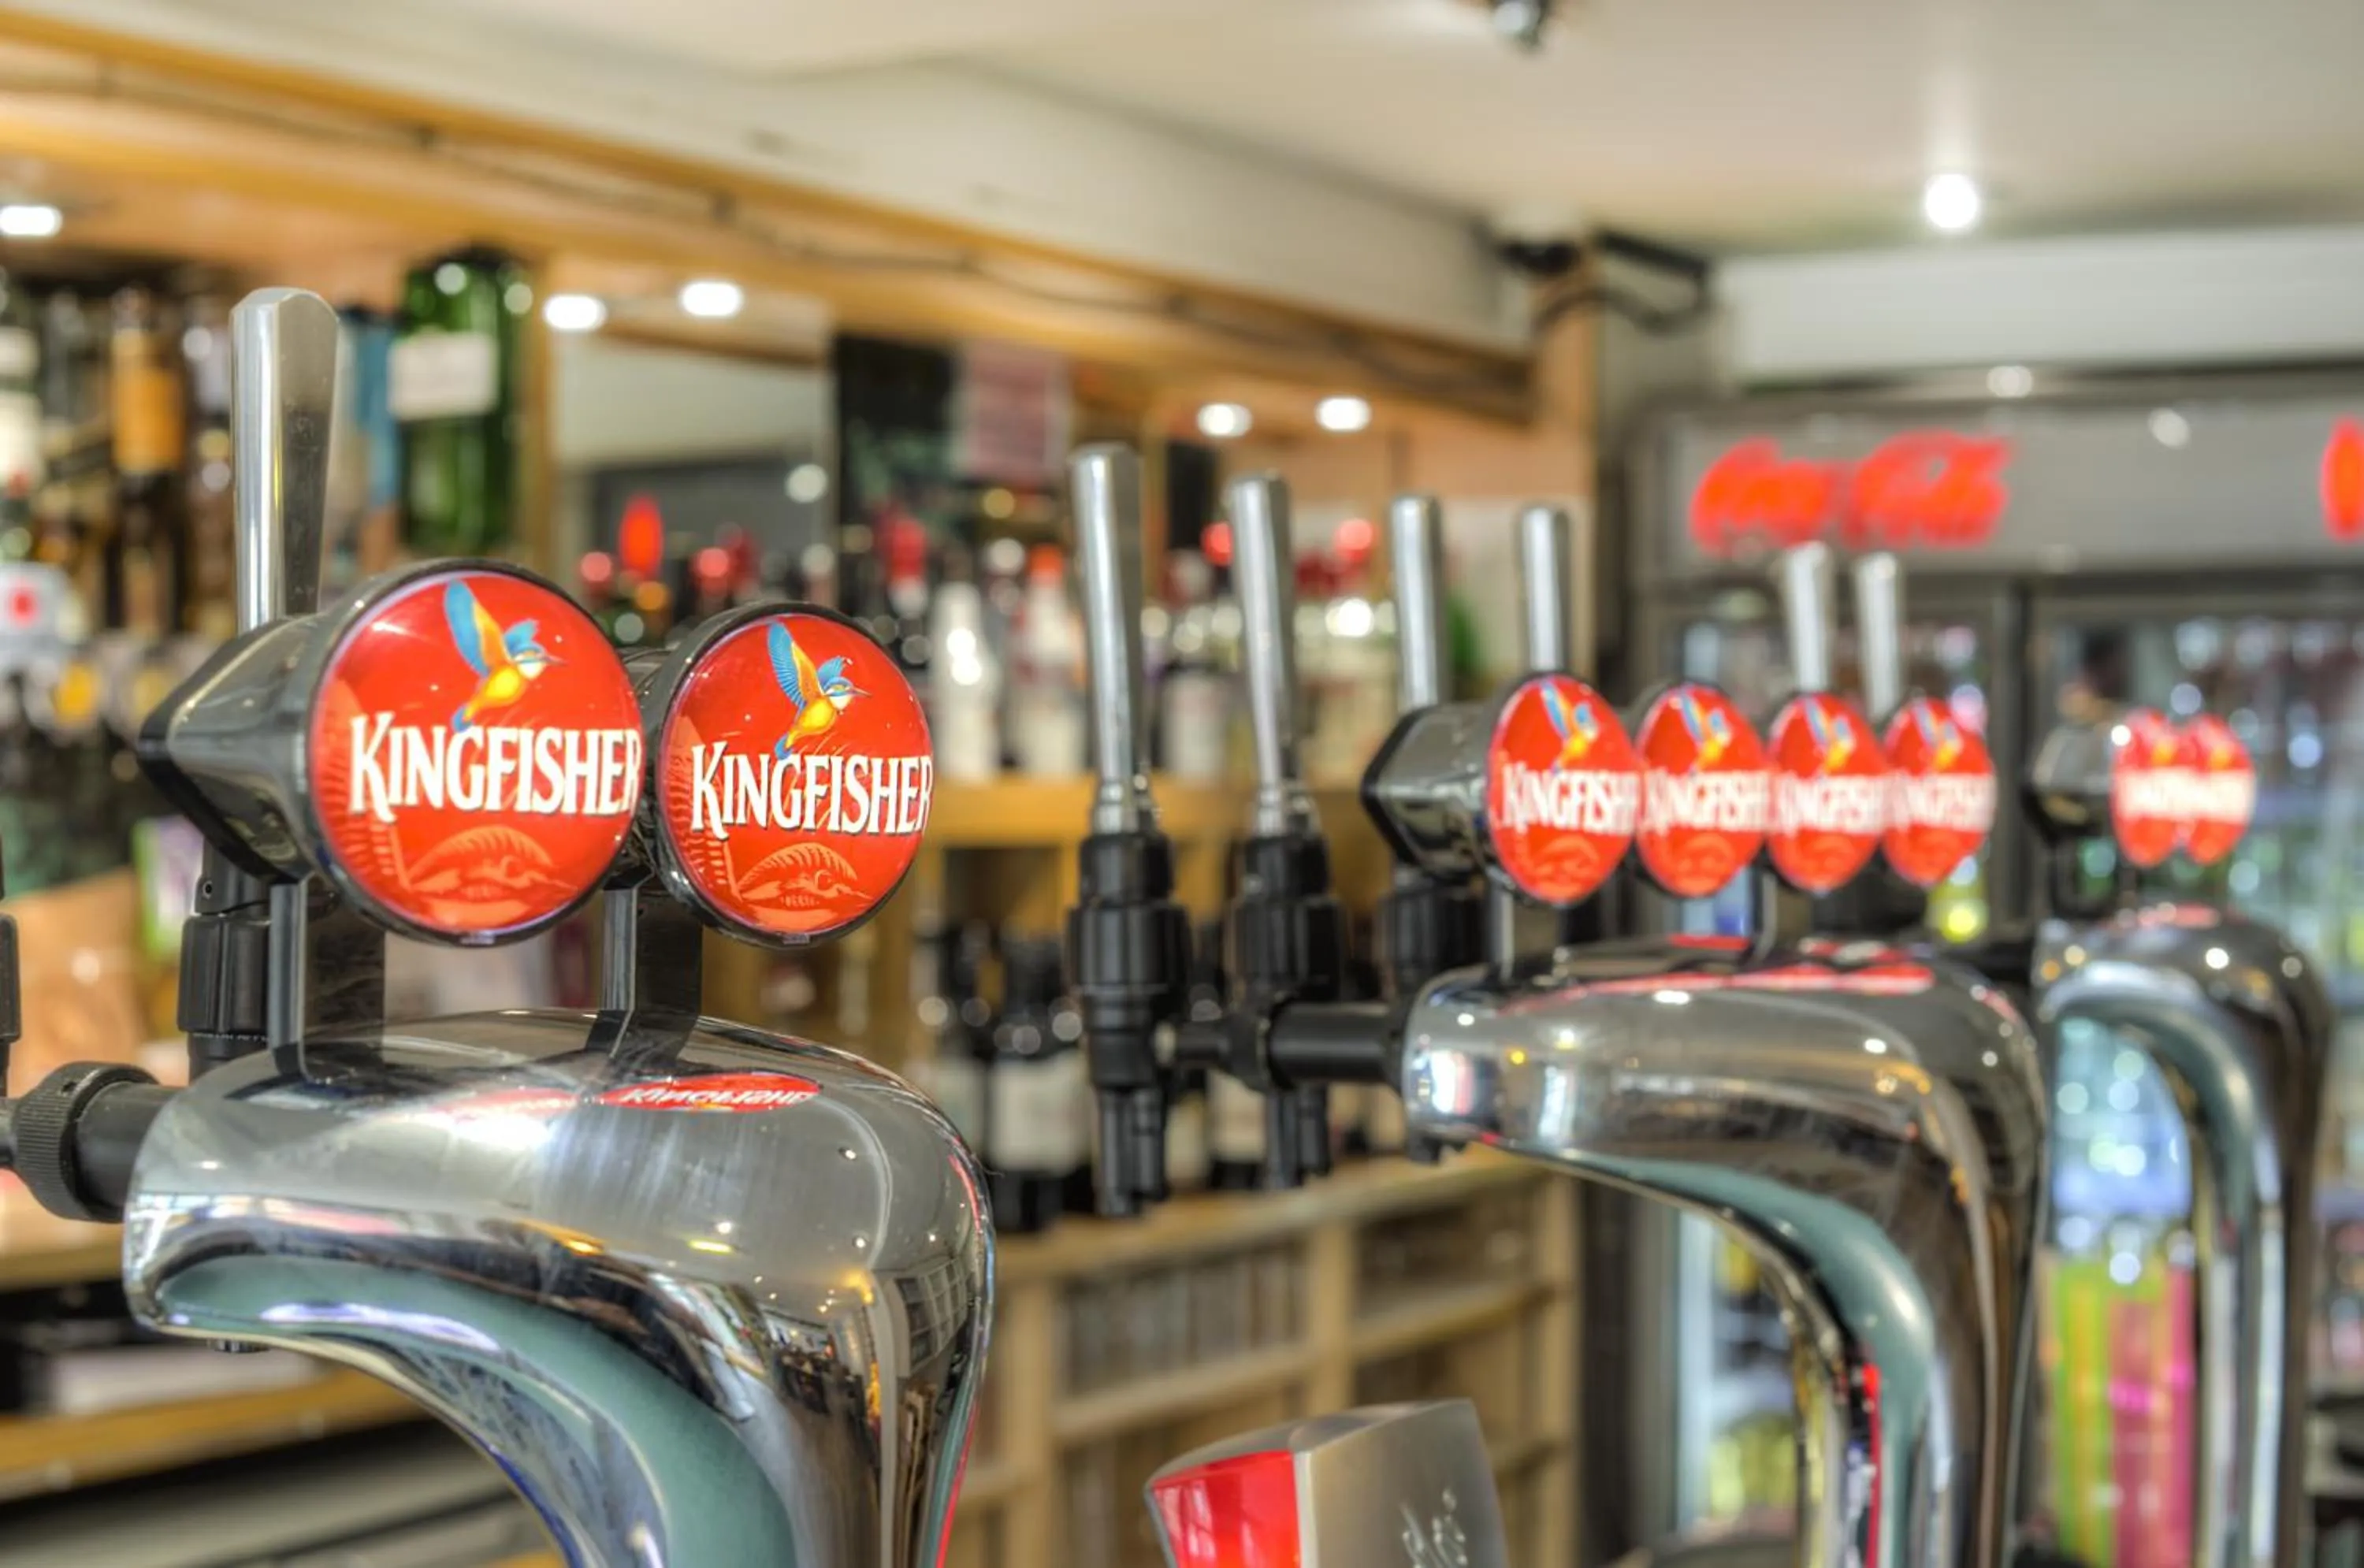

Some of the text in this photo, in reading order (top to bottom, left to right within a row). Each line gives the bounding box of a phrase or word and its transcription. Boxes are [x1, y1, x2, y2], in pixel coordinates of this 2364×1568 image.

[349, 712, 642, 823] KINGFISHER
[690, 741, 933, 840] KINGFISHER
[1502, 761, 1638, 835] KINGFISH
